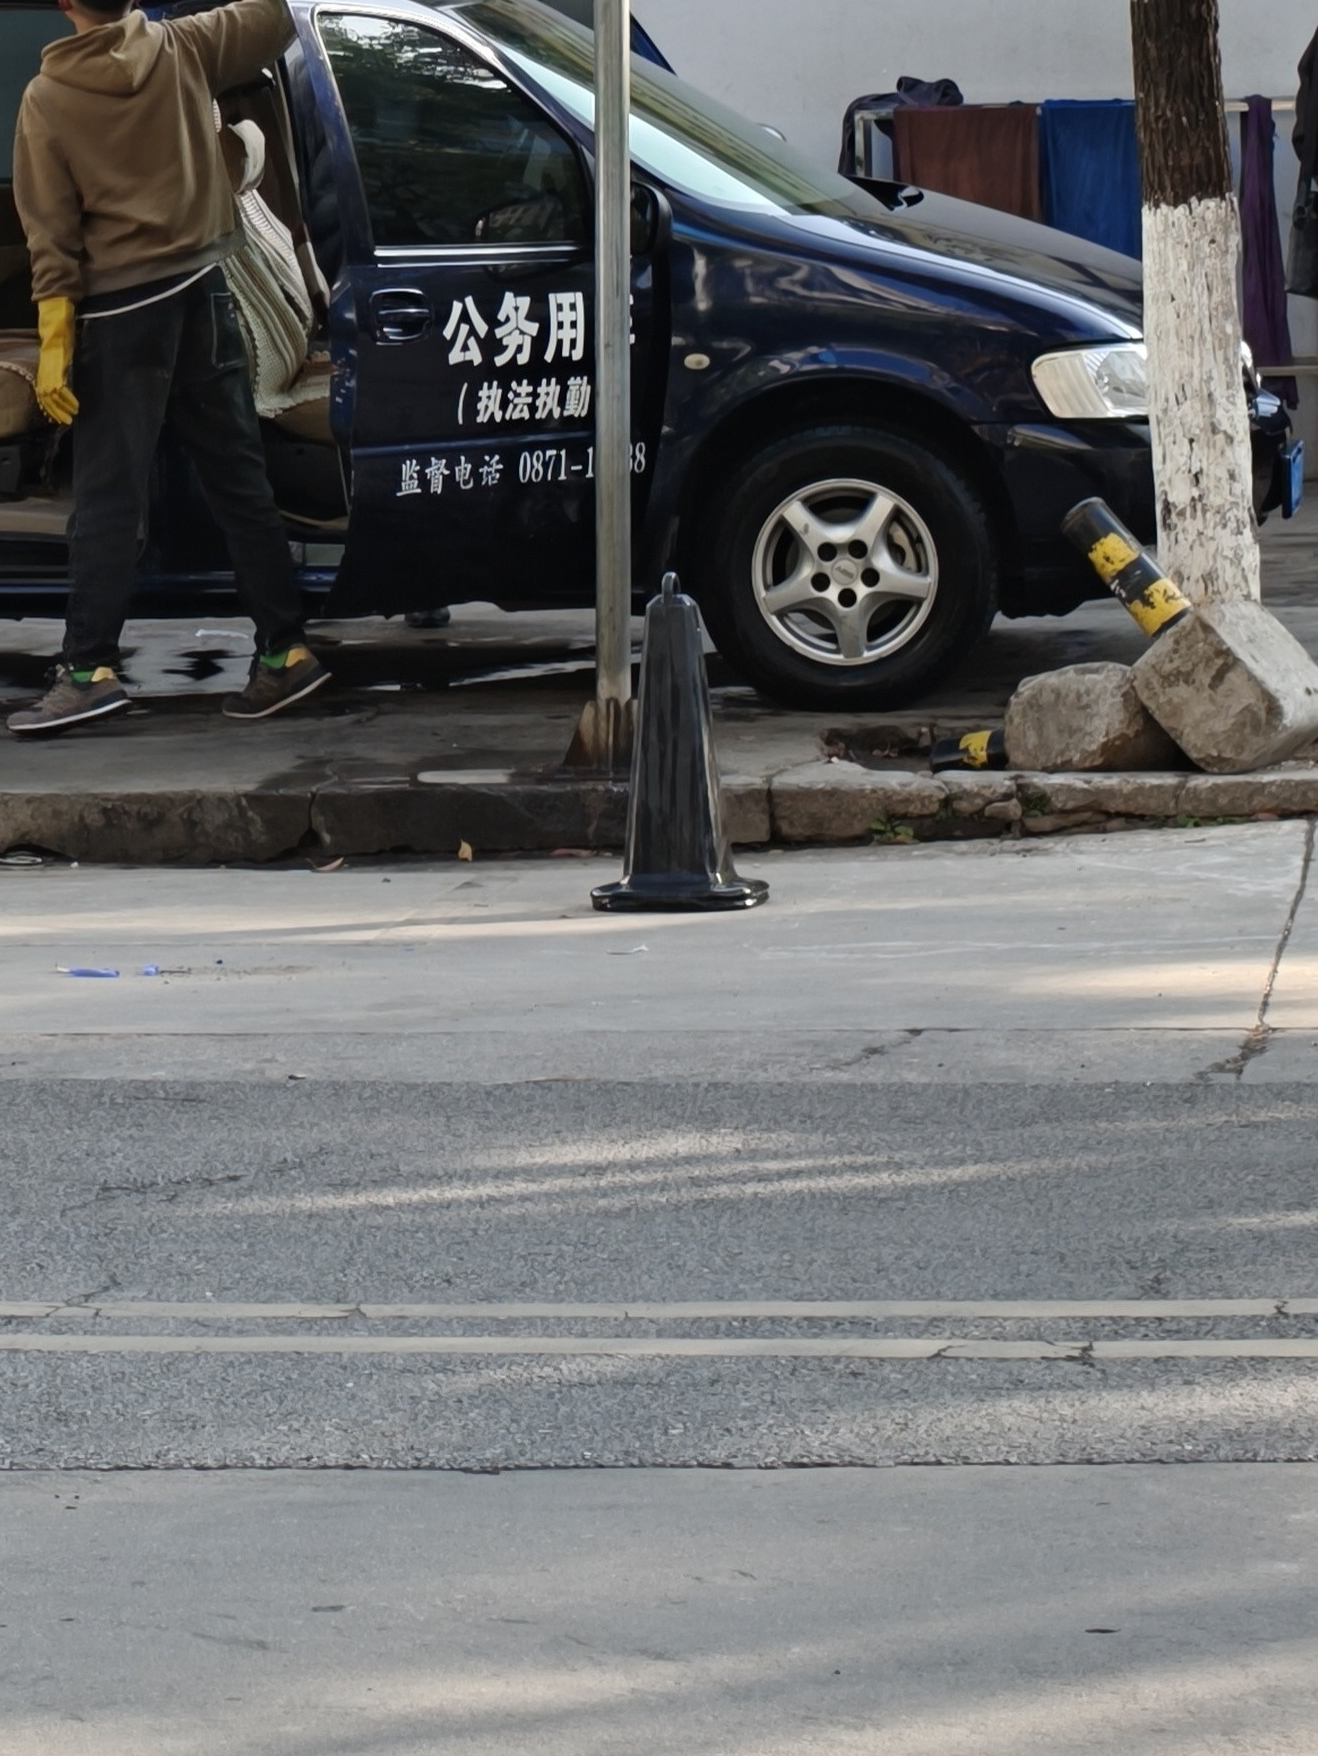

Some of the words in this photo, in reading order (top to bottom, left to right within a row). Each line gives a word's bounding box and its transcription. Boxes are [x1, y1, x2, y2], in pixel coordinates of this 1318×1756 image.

[442, 291, 635, 367] 公务用
[396, 454, 504, 497] 监督电话
[518, 441, 646, 484] 0871-18
